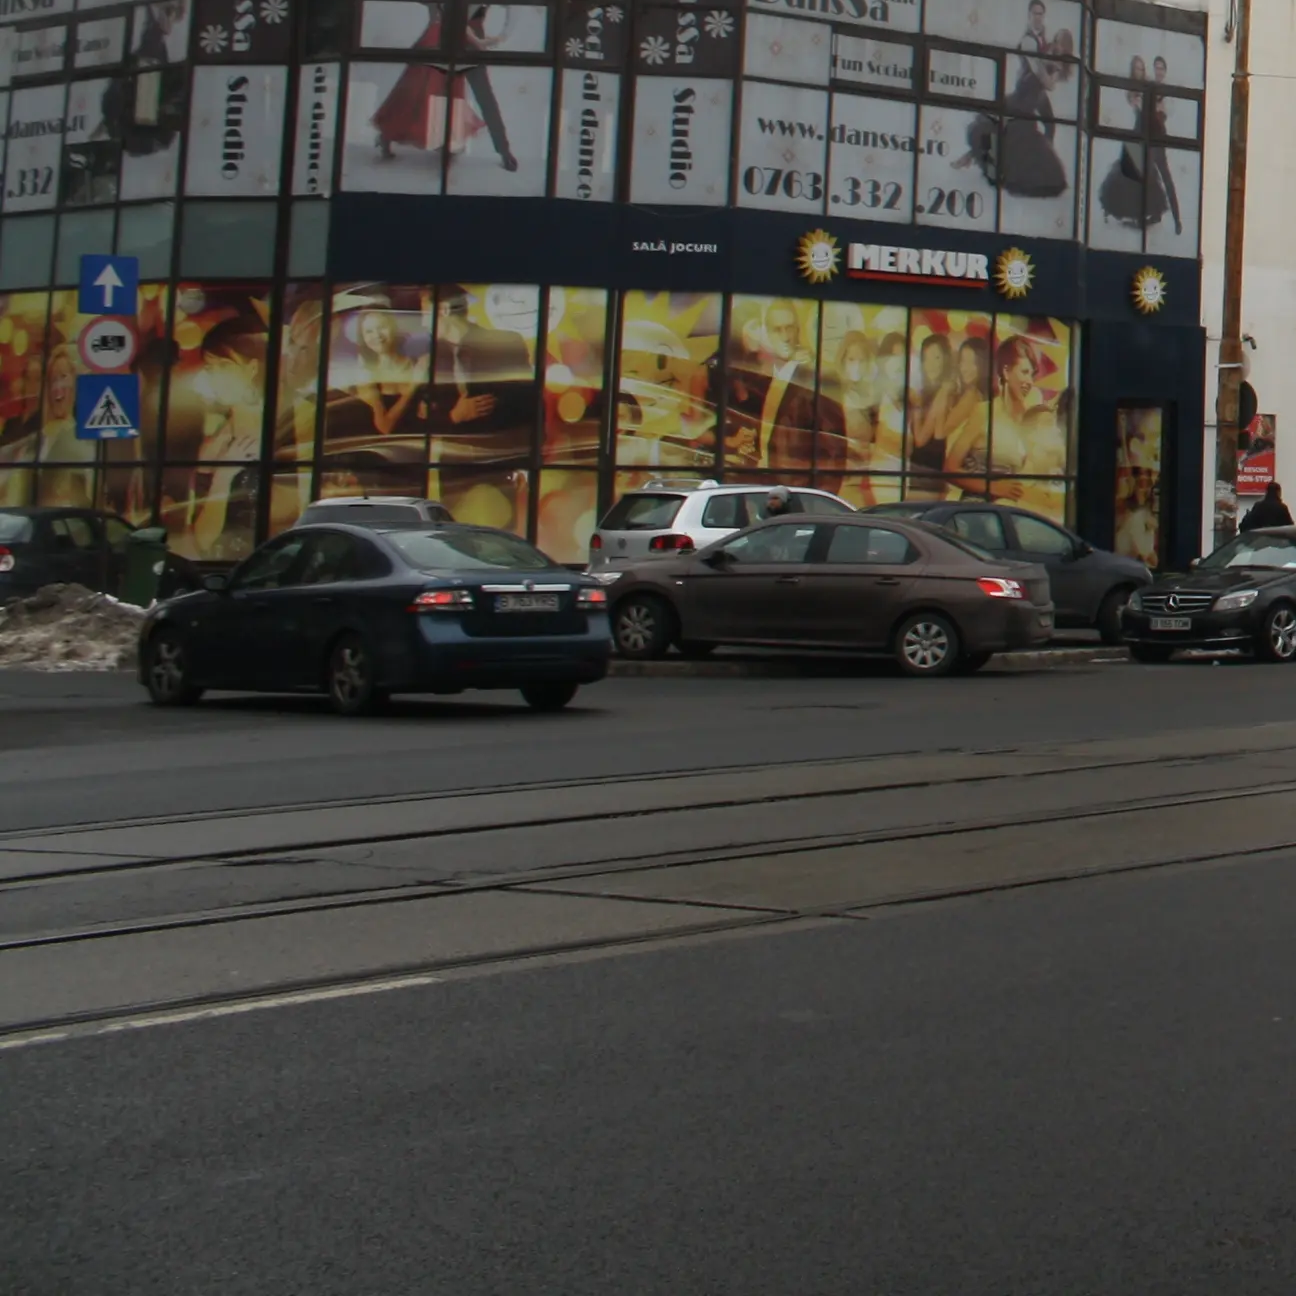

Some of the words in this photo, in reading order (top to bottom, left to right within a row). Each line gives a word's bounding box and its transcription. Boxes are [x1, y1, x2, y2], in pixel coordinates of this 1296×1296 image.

[576, 108, 600, 198] dance
[668, 86, 698, 190] Studio
[631, 239, 667, 253] SALĂ
[669, 241, 719, 254] JOCURI
[850, 242, 989, 281] MERKUR
